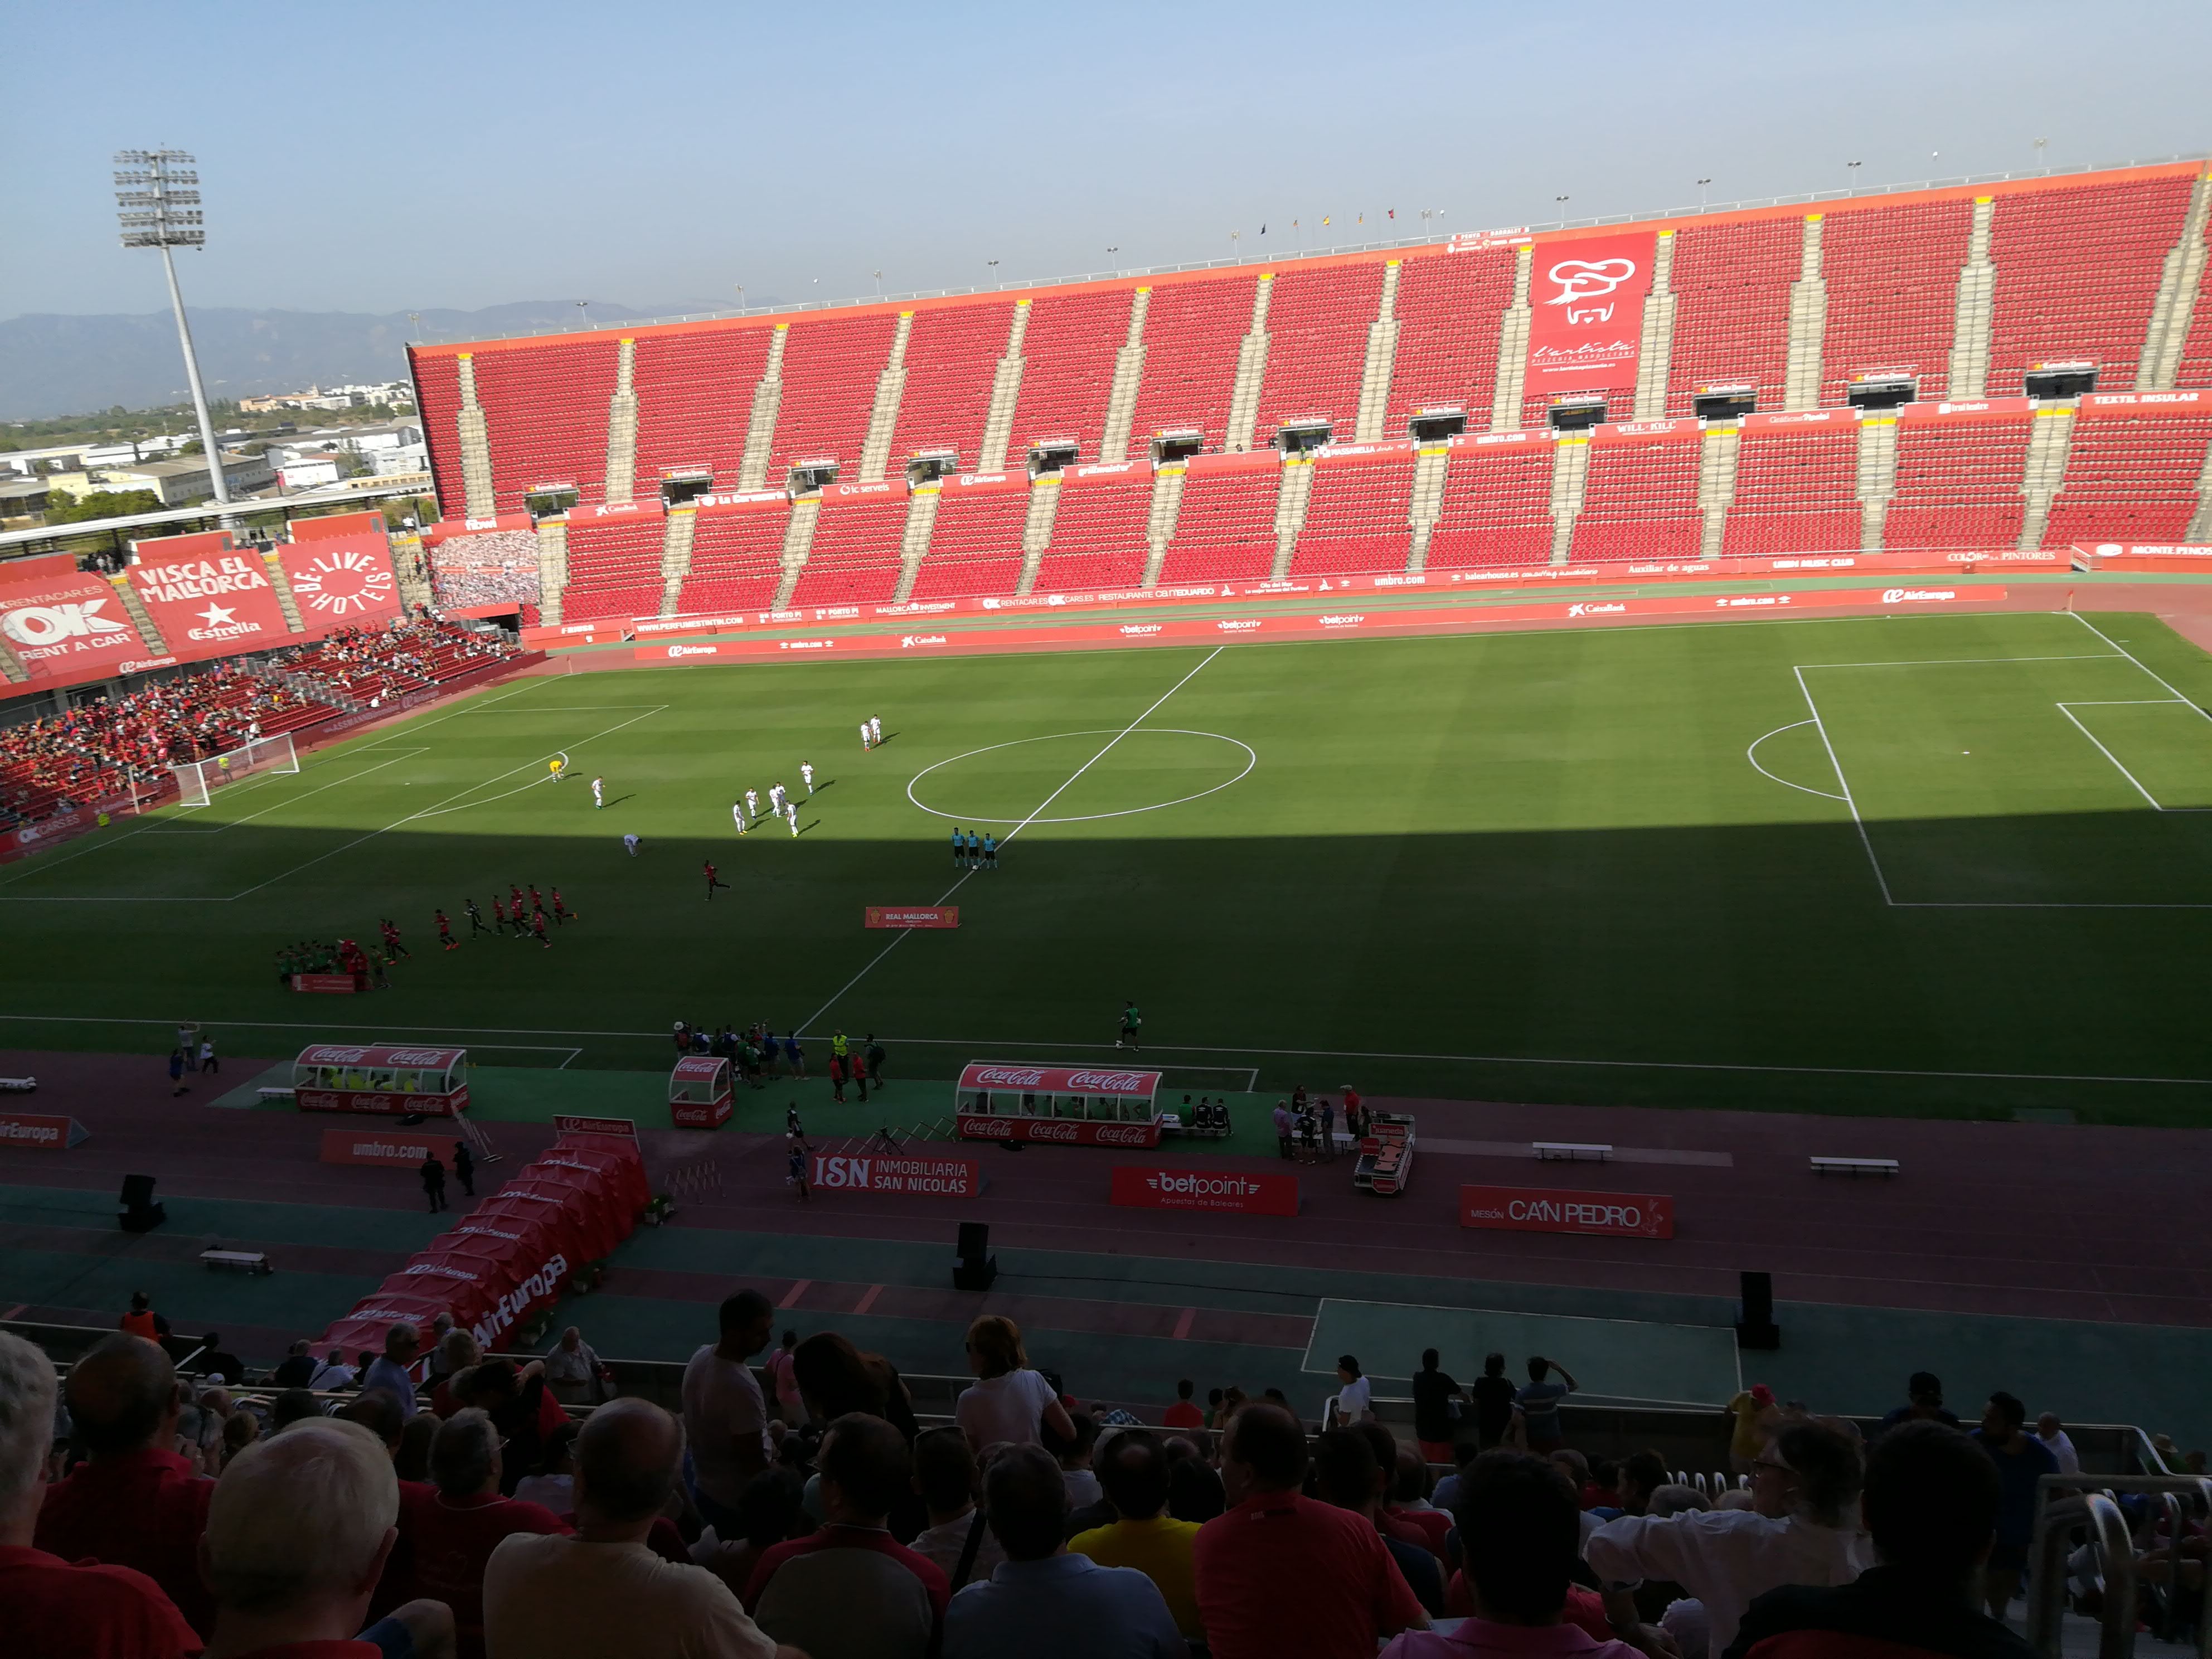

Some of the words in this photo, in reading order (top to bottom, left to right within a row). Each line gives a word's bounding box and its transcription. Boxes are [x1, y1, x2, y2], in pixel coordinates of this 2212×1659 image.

[2094, 394, 2138, 404] TEXTIL
[2141, 392, 2199, 402] INSULAR
[1477, 433, 1526, 444] umbro.com
[2002, 552, 2056, 560] PINTORES
[2131, 546, 2175, 555] MONTE
[138, 561, 219, 585] VISCA
[219, 556, 253, 574] EL
[313, 551, 375, 573] LIVE
[1628, 564, 1663, 574] Auxiliar
[1667, 564, 1679, 573] de
[1681, 563, 1710, 573] aguas
[293, 571, 323, 593] BE
[1375, 575, 1425, 586] umbro.com
[1464, 571, 1519, 580] balearhouse.es
[139, 571, 269, 603] MALLORCA
[309, 571, 392, 614] HOTELS
[1903, 590, 1955, 600] AirEuropa
[1098, 591, 1153, 601] RESTAURANTE
[2, 598, 129, 646] OK
[637, 616, 744, 632] WWW.PERFUMESTINTIN.COM
[1222, 620, 1257, 630] betpoint
[1323, 614, 1360, 624] betpoint
[187, 622, 263, 641] Estrella
[1124, 624, 1157, 634] betpoint
[18, 644, 69, 660] RENT
[75, 642, 90, 651] A
[90, 633, 132, 648] CAR
[976, 1068, 1048, 1086] Coca-Cola
[1067, 1071, 1147, 1092] Coca-Cola
[1374, 1126, 1404, 1135] juaneda
[352, 1141, 428, 1159] umbro.com
[813, 1157, 872, 1188] ISN
[876, 1160, 968, 1177] INMOBILIARIA
[874, 1176, 903, 1190] SAN
[907, 1176, 967, 1194] NICOLÁS
[1159, 1172, 1247, 1197] betpoint
[1160, 1197, 1195, 1205] Apuestas
[1210, 1199, 1244, 1208] Baleares
[1471, 1208, 1504, 1219] MESÓN
[1565, 1203, 1641, 1227] PEDRO
[473, 1253, 568, 1348] AirEuropa
